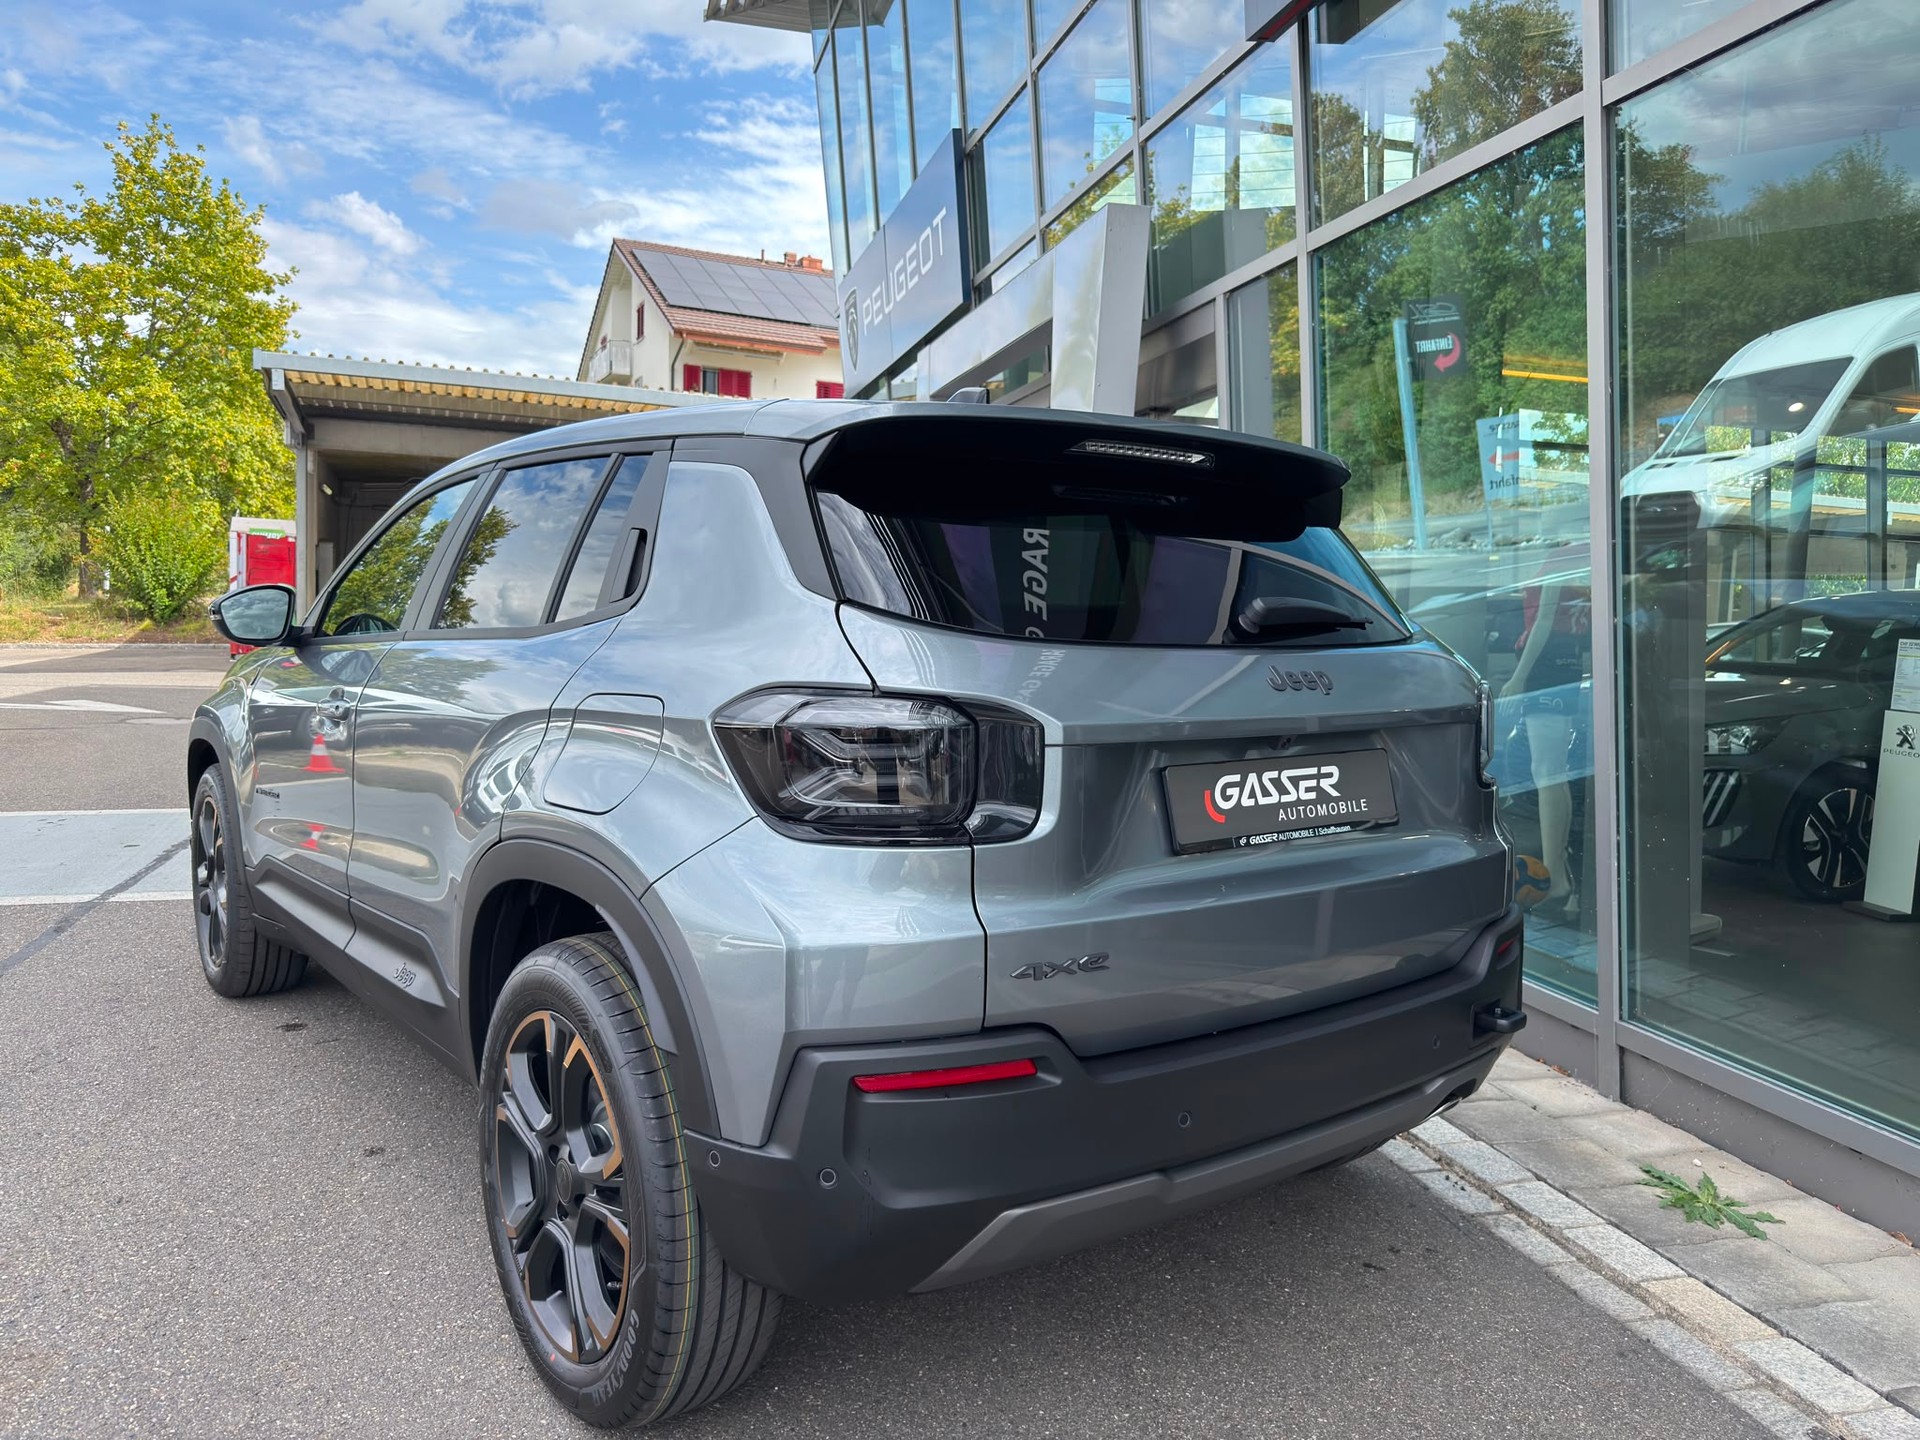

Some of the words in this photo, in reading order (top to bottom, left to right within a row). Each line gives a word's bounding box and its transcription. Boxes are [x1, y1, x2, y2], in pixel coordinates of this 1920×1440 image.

[862, 206, 947, 336] PEUGEOT
[1266, 664, 1334, 696] Jeep
[1883, 747, 1920, 759] PEUGEO
[1214, 765, 1342, 810] GASSER
[1278, 798, 1369, 822] AUTOMOBILE
[1249, 833, 1278, 845] GASSER
[1278, 828, 1314, 841] AUTOMOBILE
